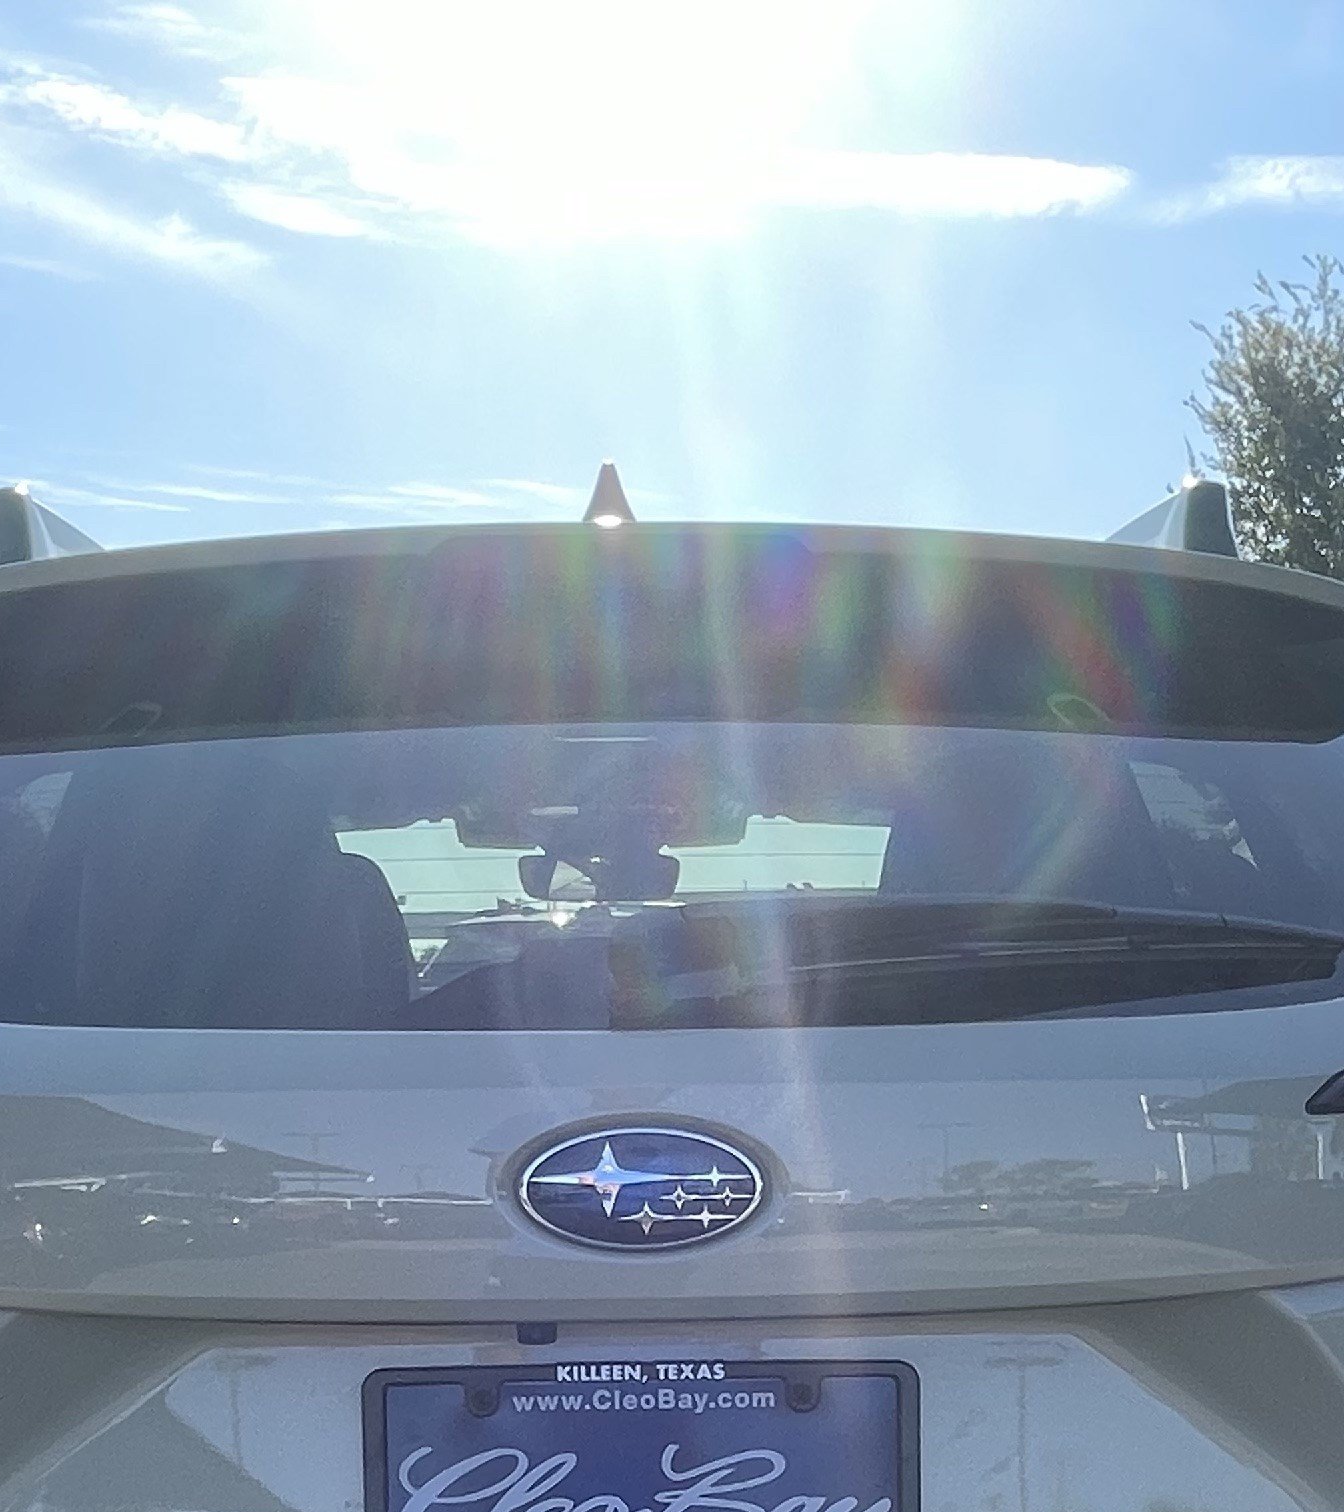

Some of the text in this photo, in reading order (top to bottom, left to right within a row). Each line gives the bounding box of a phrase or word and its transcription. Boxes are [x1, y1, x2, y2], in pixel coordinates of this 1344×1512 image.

[556, 1363, 726, 1384] KILLEEN, TEXAS
[512, 1388, 776, 1414] www.CleoBay.com
